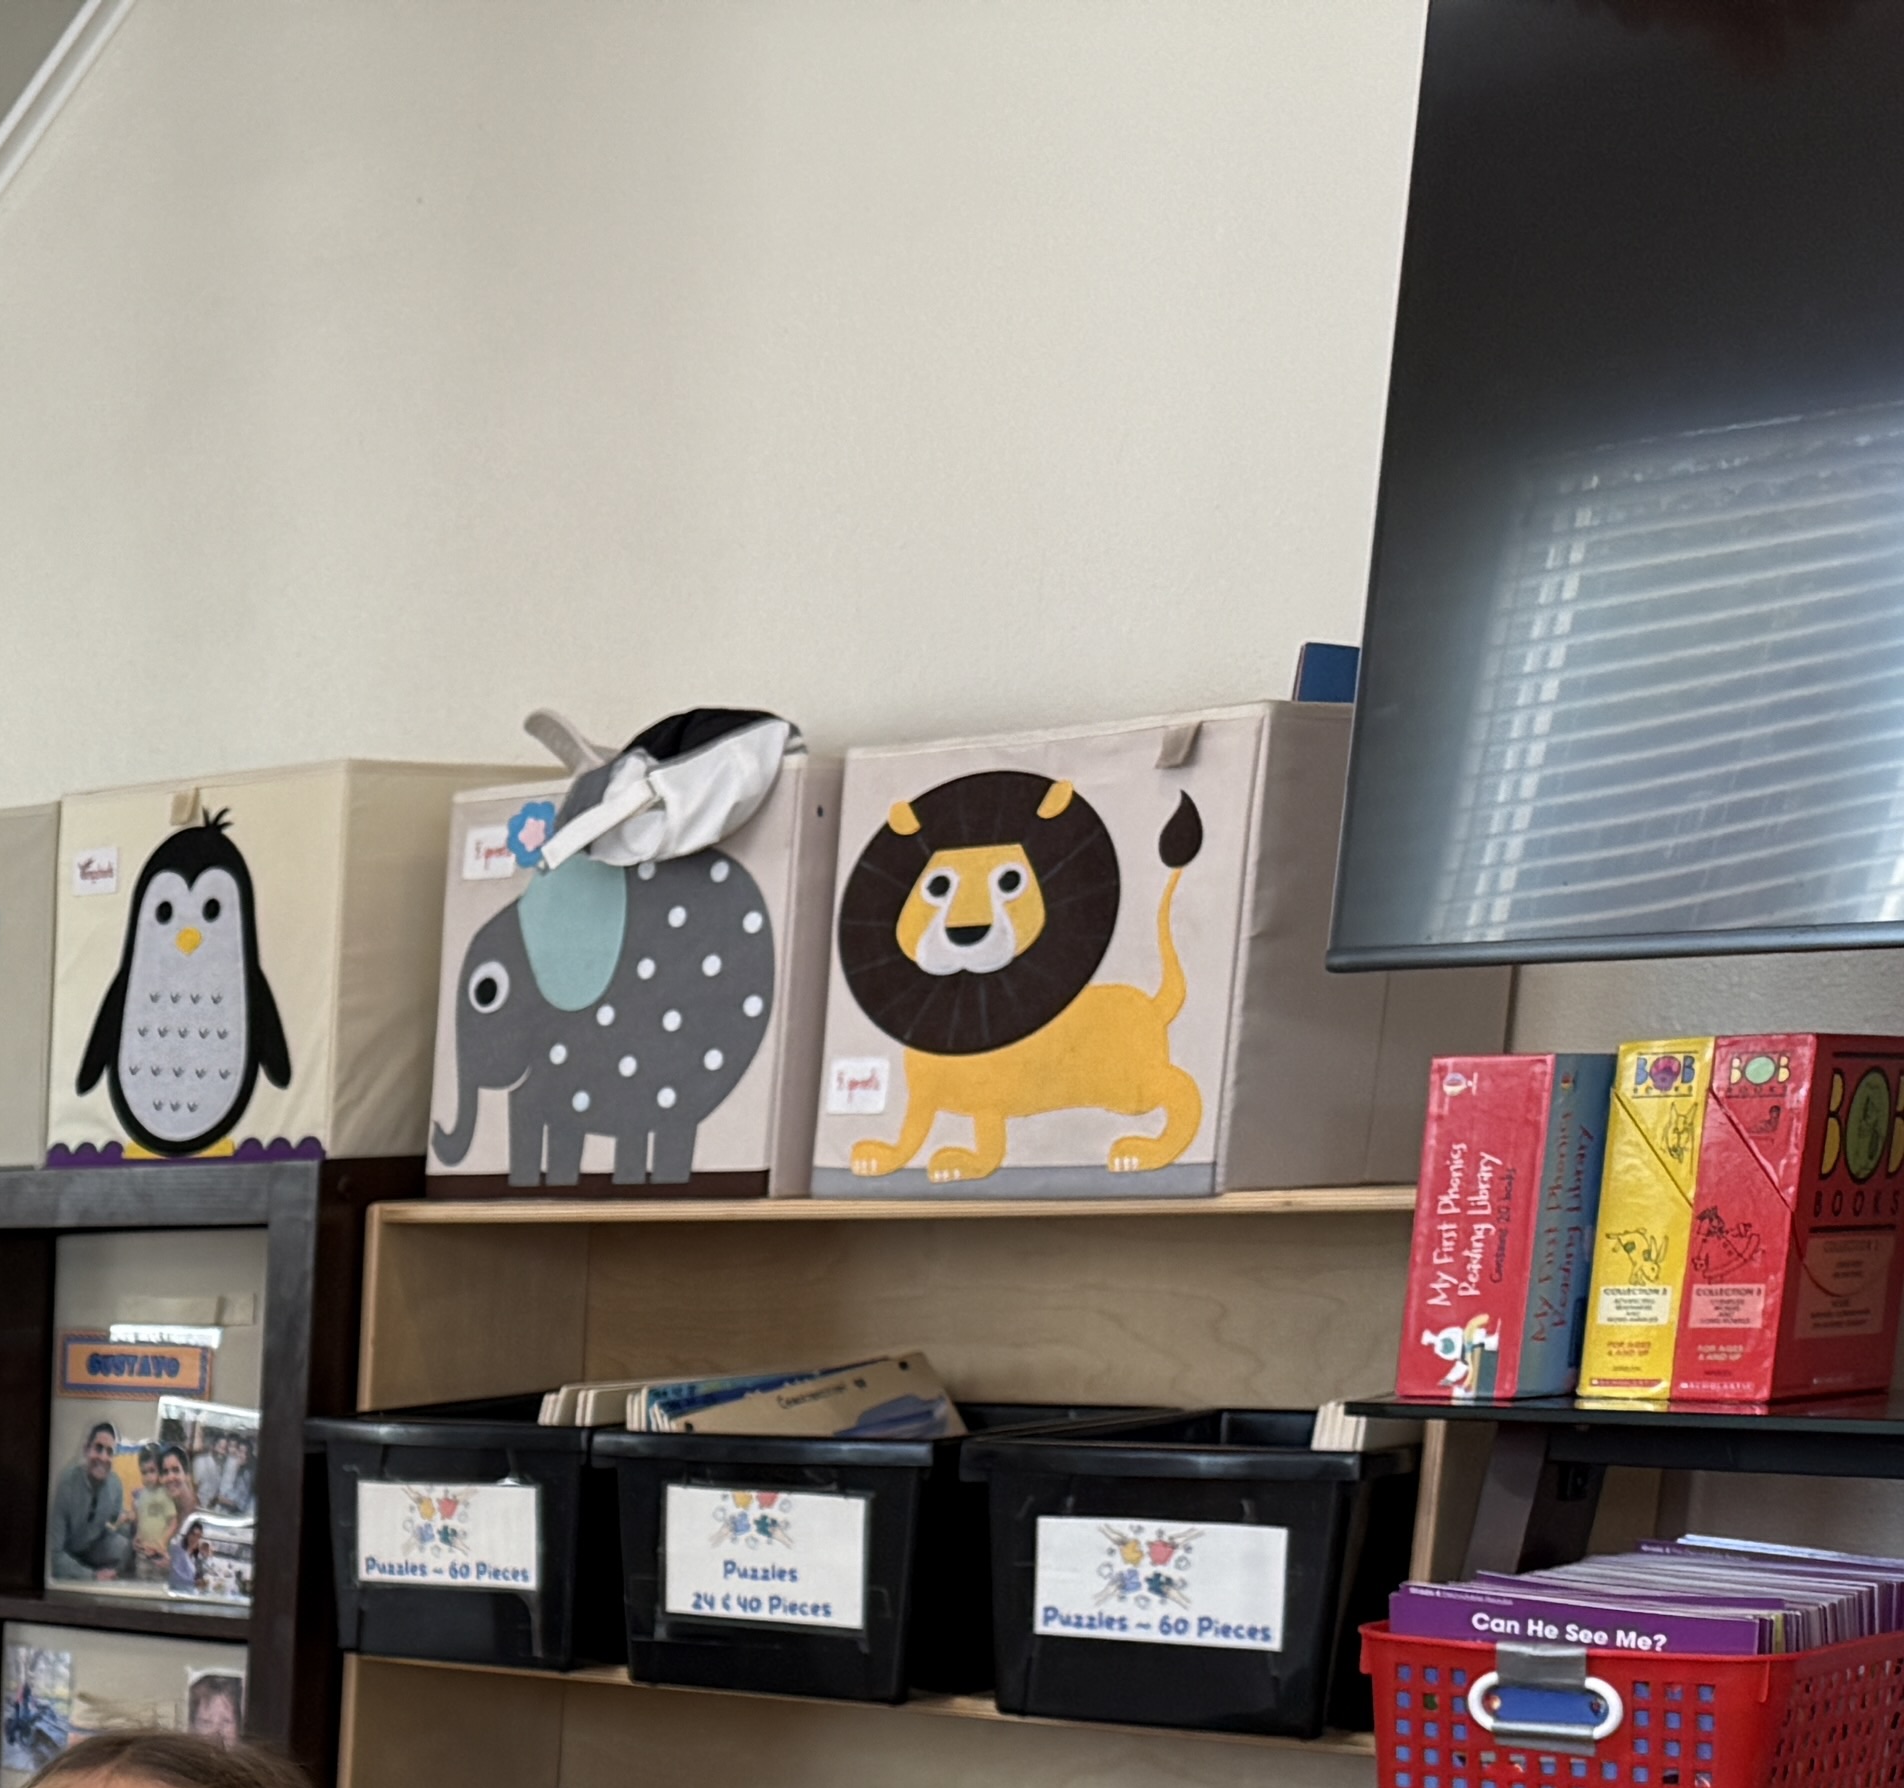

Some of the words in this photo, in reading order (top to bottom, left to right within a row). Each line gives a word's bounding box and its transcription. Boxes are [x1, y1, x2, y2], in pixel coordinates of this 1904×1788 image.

[1436, 1142, 1468, 1215] Phonics
[1466, 1151, 1503, 1216] Library
[1813, 1189, 1900, 1219] BOOKS
[1432, 1221, 1459, 1264] First
[1457, 1223, 1496, 1297] Reading
[1426, 1271, 1460, 1306] My
[365, 1555, 428, 1577] Puzzles
[448, 1560, 471, 1580] 60
[475, 1561, 530, 1583] Pieces
[723, 1559, 798, 1583] Puzzles
[692, 1592, 716, 1612] 24
[737, 1594, 763, 1614] 40
[768, 1595, 833, 1618] Pieces
[1042, 1605, 1129, 1632] Puzzles
[1158, 1614, 1191, 1636] 60
[1196, 1616, 1273, 1643] Pieces
[1471, 1611, 1520, 1636] Can
[1526, 1619, 1559, 1640] He
[1565, 1623, 1610, 1646] See
[1615, 1629, 1668, 1652] Me?
